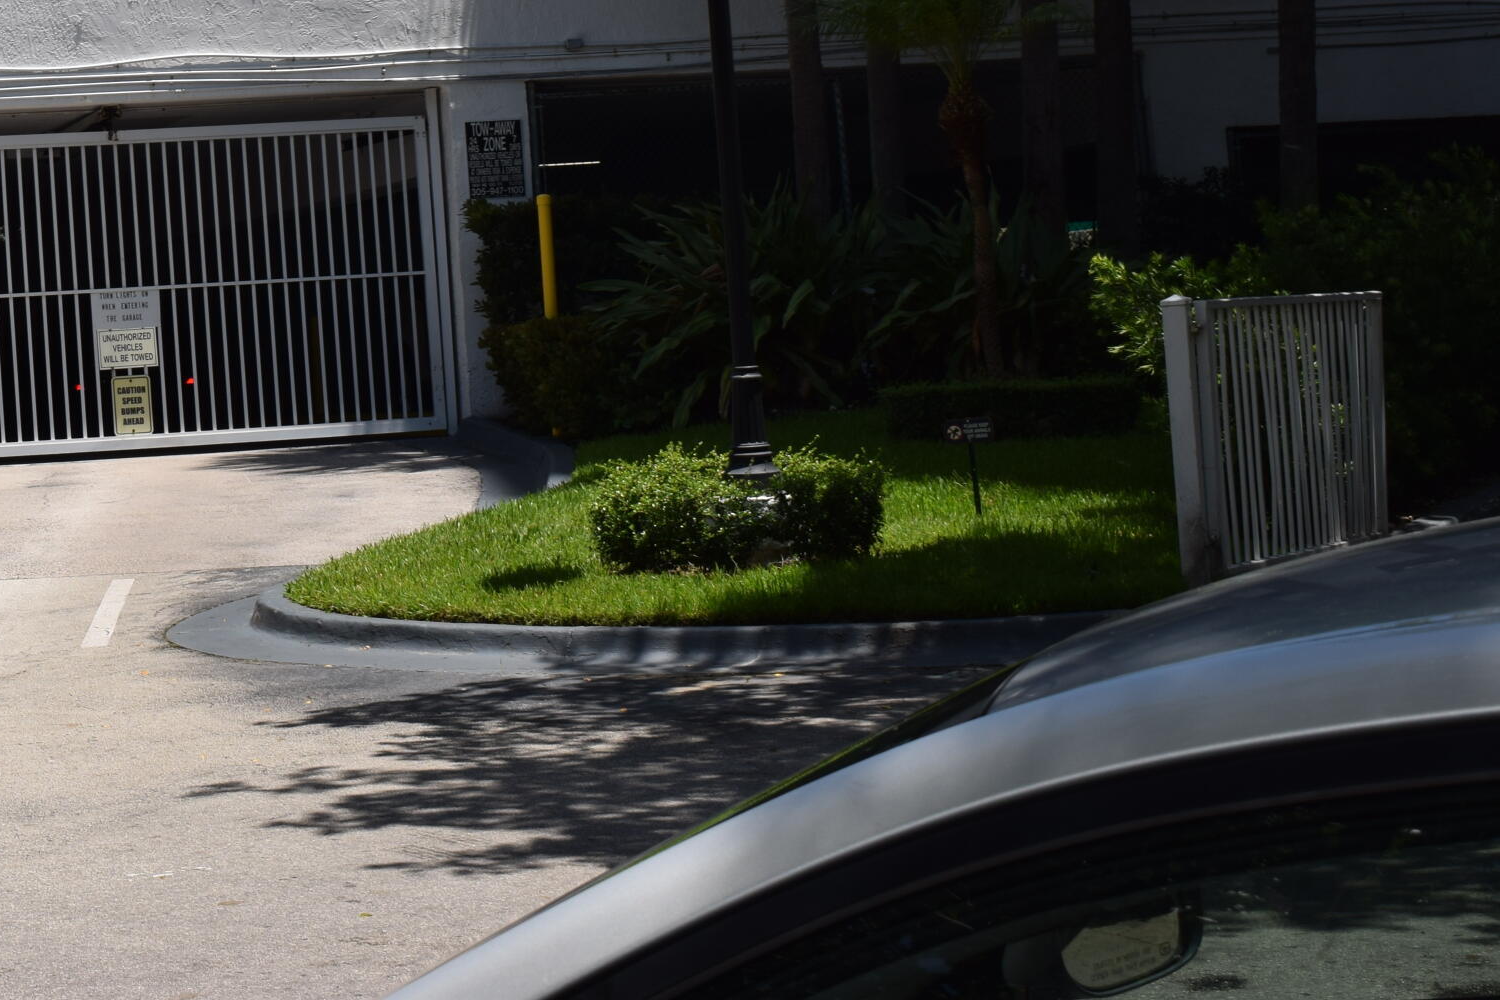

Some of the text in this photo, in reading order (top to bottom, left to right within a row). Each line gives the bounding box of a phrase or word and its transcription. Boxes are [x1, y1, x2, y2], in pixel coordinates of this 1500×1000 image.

[470, 121, 515, 137] TOW-AWAY
[512, 134, 517, 142] 7
[483, 136, 507, 151] ZONE
[100, 290, 149, 300] TURN LIGHTS ON
[101, 301, 149, 311] WHEN ENTERING
[106, 315, 117, 323] THE
[102, 331, 151, 343] UNAUTHORIZED
[112, 343, 143, 352] VEHICLES
[103, 352, 154, 363] WILL BE TOWED
[117, 386, 146, 395] CAUTION
[122, 396, 142, 405] SPEED
[121, 407, 145, 416] BUMPS
[123, 417, 145, 426] AHEAD
